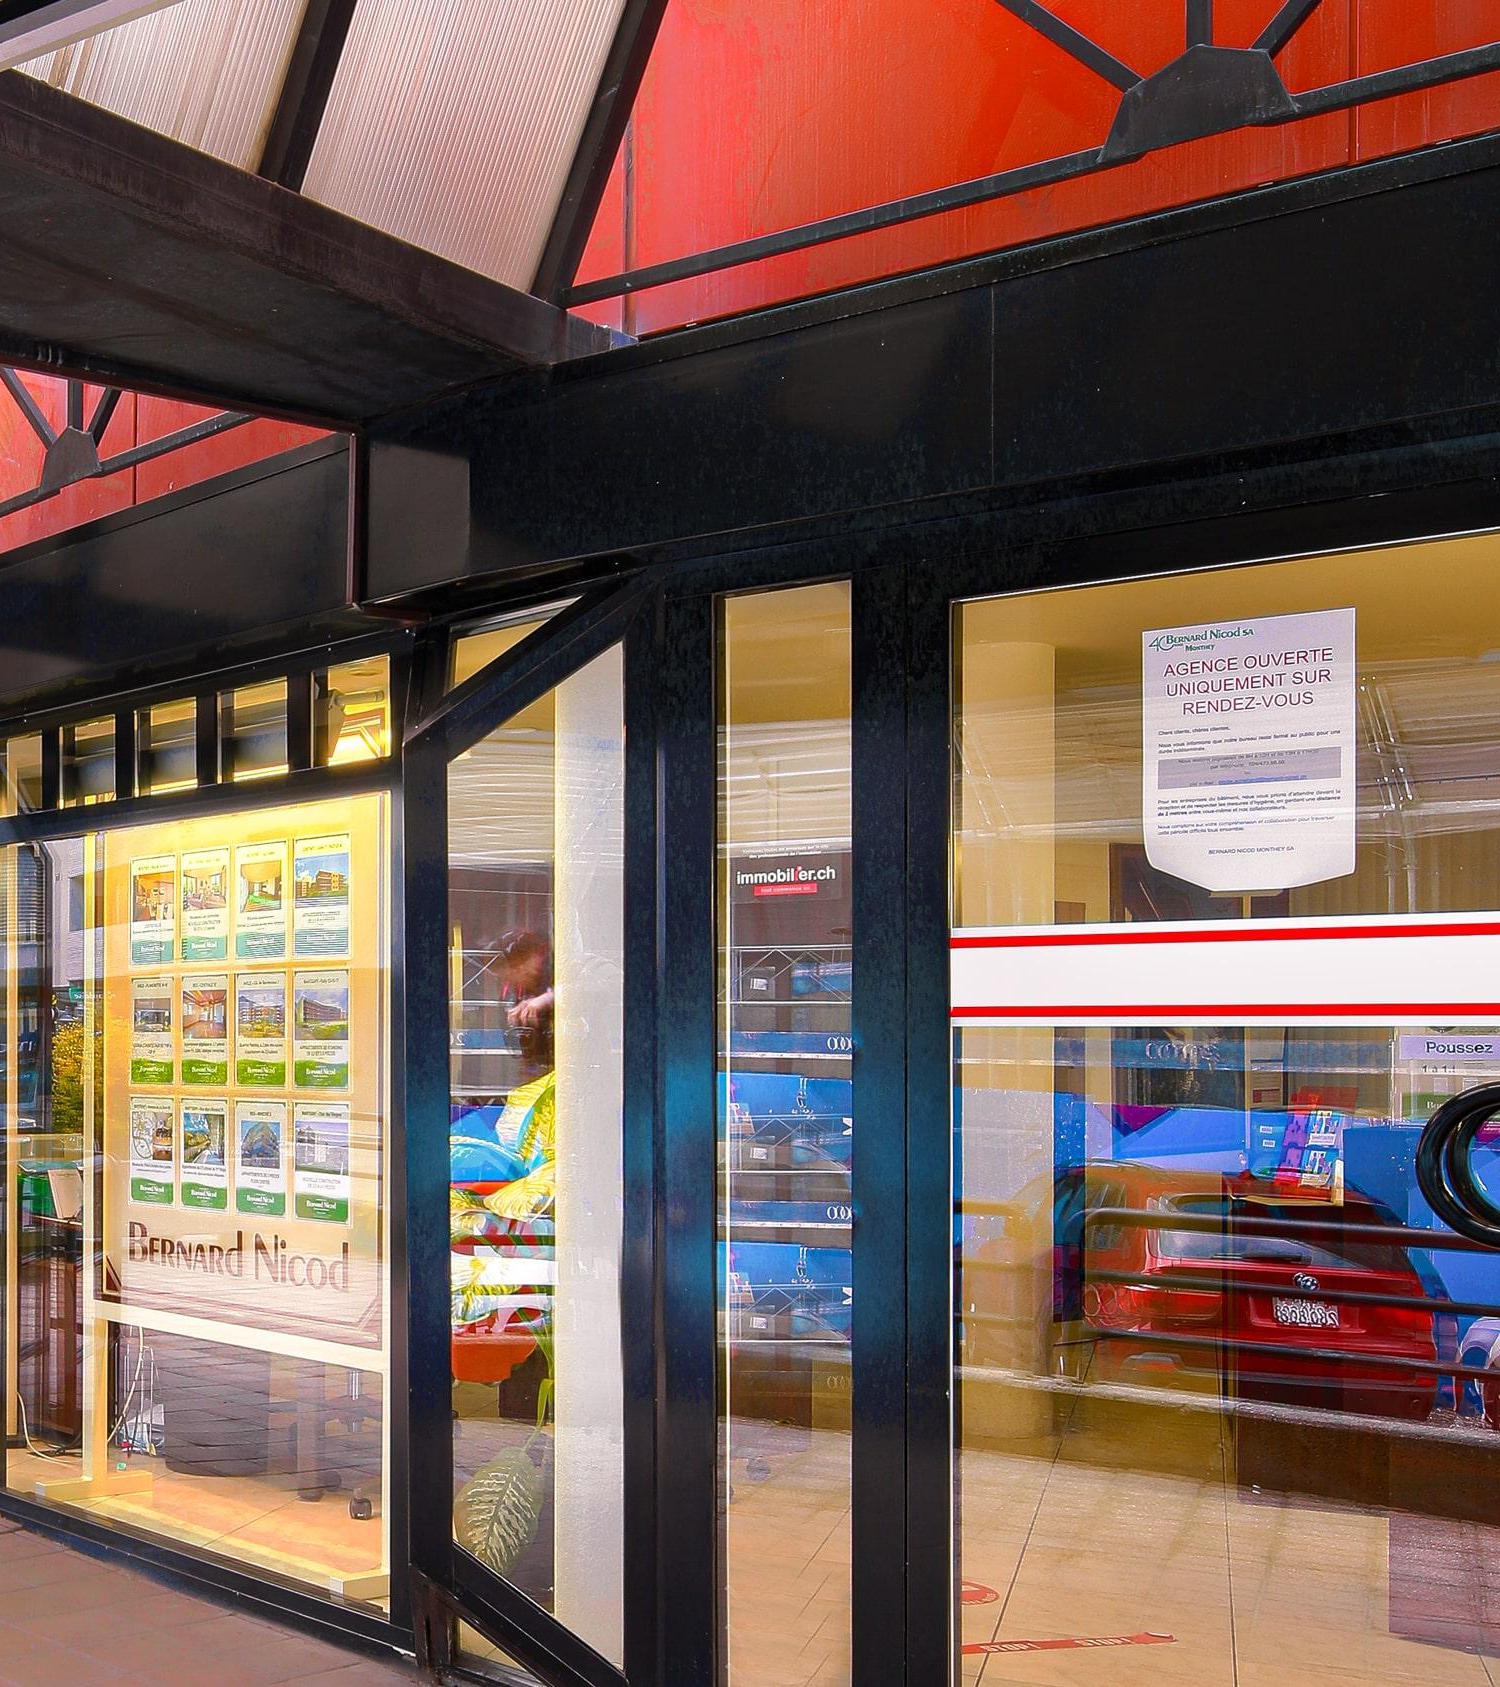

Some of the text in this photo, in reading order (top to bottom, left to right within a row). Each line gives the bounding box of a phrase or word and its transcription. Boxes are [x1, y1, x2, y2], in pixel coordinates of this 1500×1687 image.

[1209, 627, 1240, 639] Nicod
[1242, 628, 1254, 636] SA
[1164, 648, 1334, 678] AGENCE OUVERTE
[1166, 669, 1331, 698] UNIQUEMENT SUR
[1183, 691, 1314, 715] RENDEZ-VOUS
[737, 865, 836, 885] immobilier.ch
[1426, 1041, 1494, 1054] Poussez
[254, 1232, 349, 1293] Nicod
